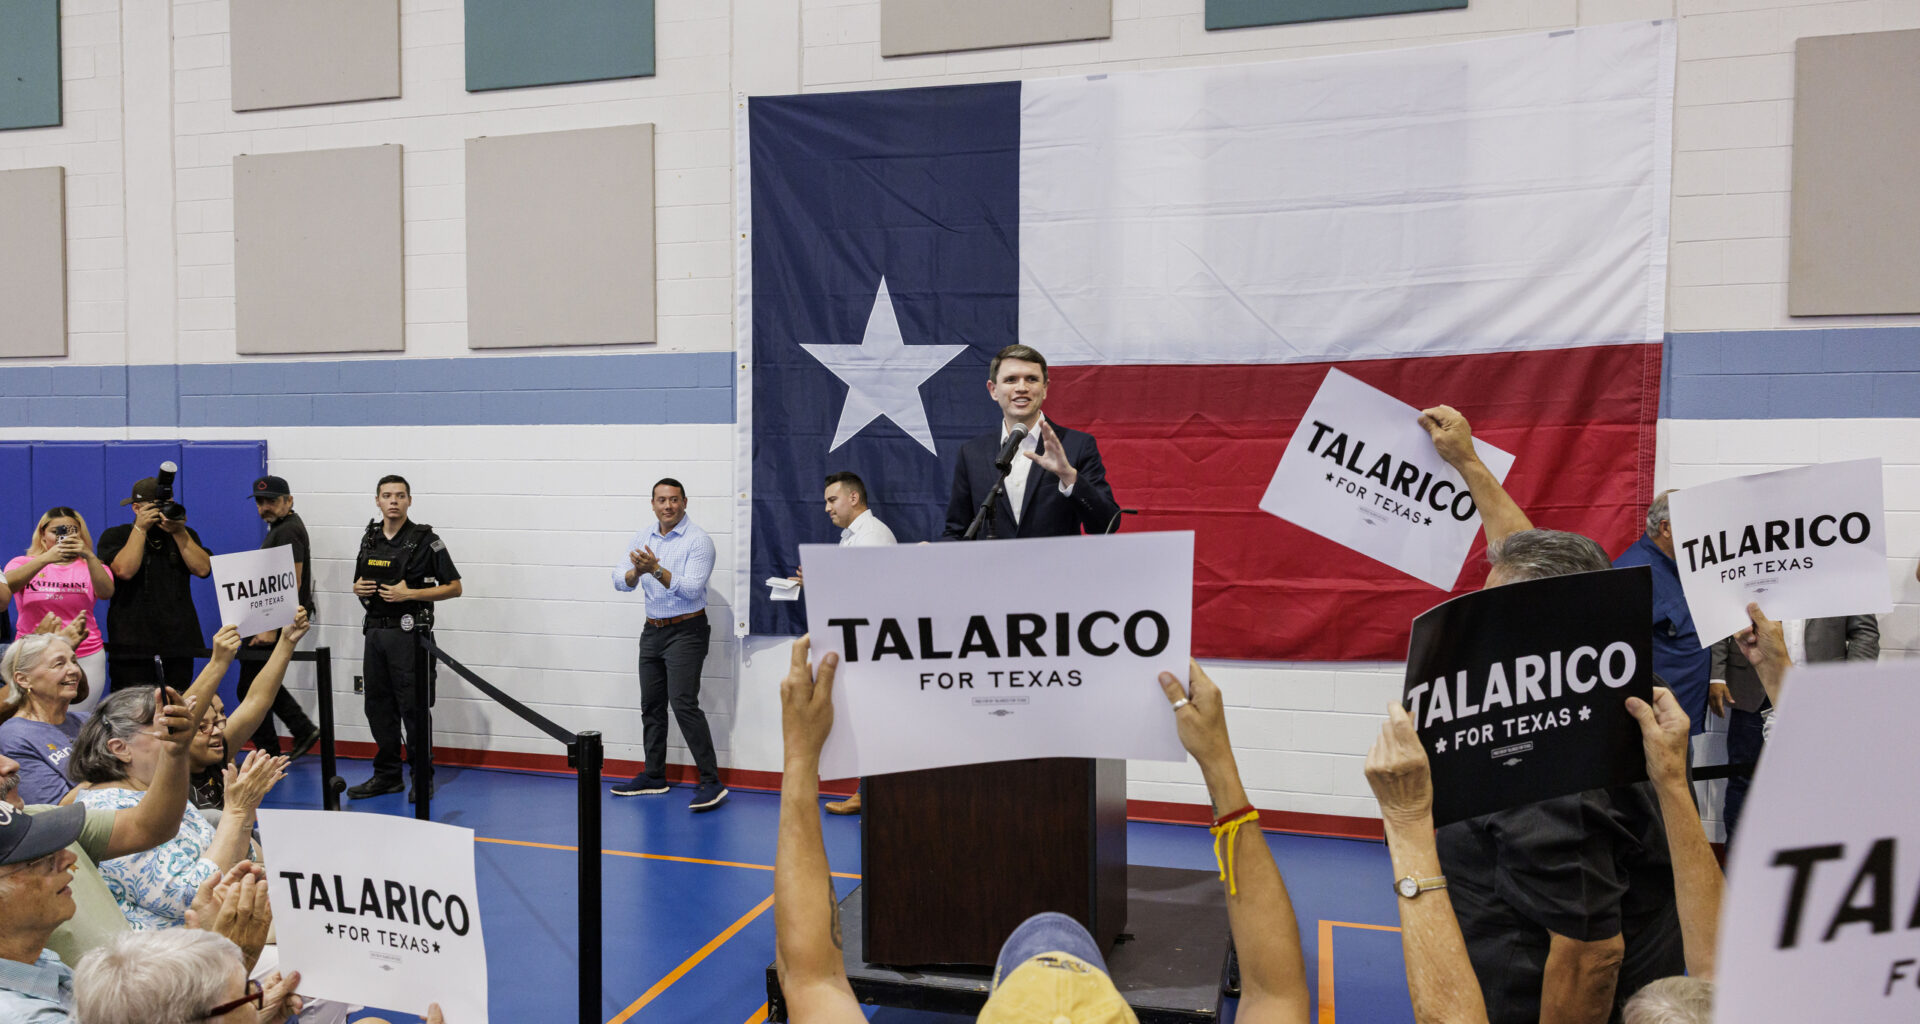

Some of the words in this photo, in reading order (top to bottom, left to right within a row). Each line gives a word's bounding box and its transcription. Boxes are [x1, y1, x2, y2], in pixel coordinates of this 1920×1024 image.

[1307, 420, 1477, 522] TALARICO
[1335, 477, 1366, 502] FOR
[1373, 492, 1423, 524] TEXAS
[368, 559, 391, 567] SECURITY
[1682, 511, 1871, 573] TALARICO
[222, 571, 295, 602] TALARICO
[1720, 565, 1746, 583] FOR
[1753, 556, 1814, 575] TEXAS
[250, 601, 263, 609] FOR
[265, 595, 284, 606] TEXAS
[827, 610, 1170, 662] TALARICO
[920, 672, 974, 690] FOR
[988, 670, 1083, 689] TEXAS
[1407, 641, 1637, 732] TALARICO
[1454, 723, 1494, 751] FOR
[1502, 707, 1571, 738] TEXAS
[280, 871, 470, 937] TALARICO
[1767, 836, 1920, 949] TA
[338, 924, 371, 943] FOR
[376, 929, 430, 954] TEXAS
[1884, 959, 1920, 996] F
